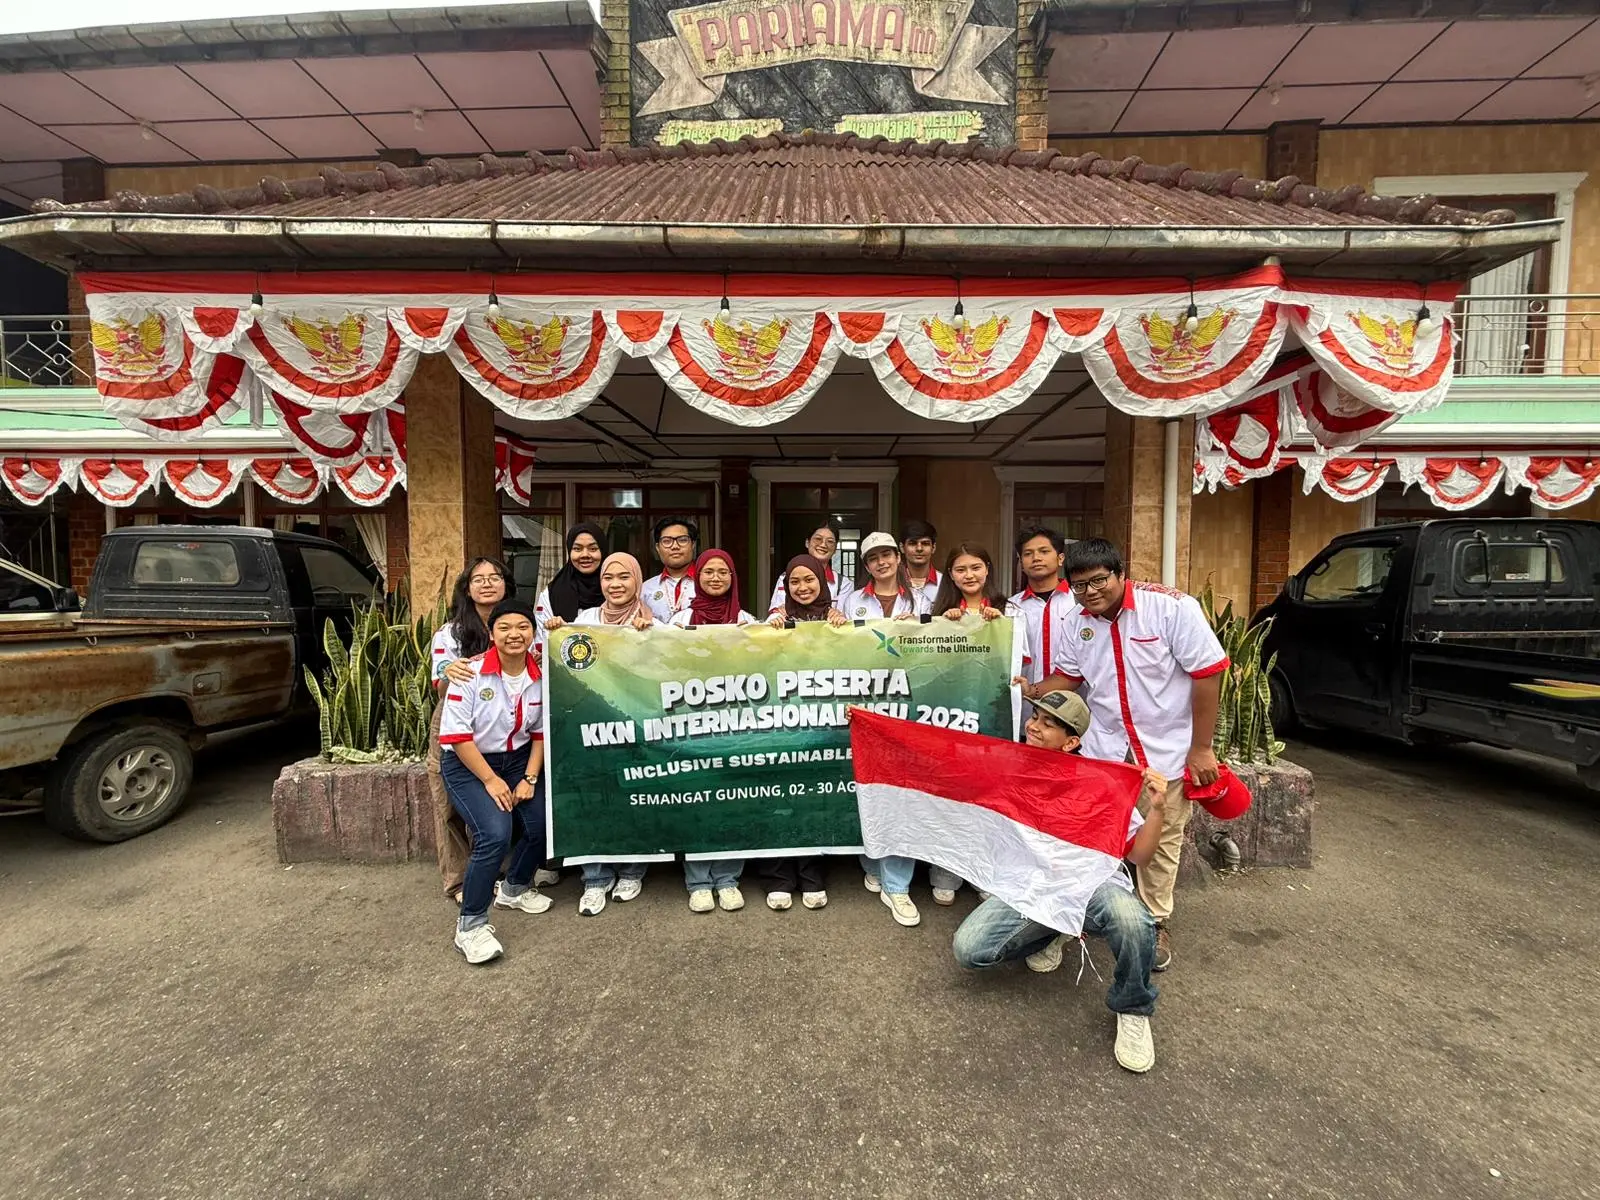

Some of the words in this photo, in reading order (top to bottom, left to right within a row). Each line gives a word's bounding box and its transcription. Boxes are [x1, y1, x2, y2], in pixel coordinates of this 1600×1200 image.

[899, 634, 968, 645] Transformation
[899, 644, 934, 654] Towards
[936, 644, 952, 654] the
[953, 643, 991, 654] Ultimate
[660, 672, 768, 710] POSKO
[776, 668, 910, 698] PESERTA
[580, 720, 636, 747] KKN
[643, 703, 849, 742] INTERNASIONAL
[916, 704, 980, 735] 2025
[623, 756, 724, 781] INCLUSIVE
[729, 747, 852, 768] SUSTAINABLE
[629, 790, 712, 806] SEMANGAT
[715, 784, 785, 801] GUNUNG,
[788, 783, 806, 796] 02
[816, 781, 833, 794] 30
